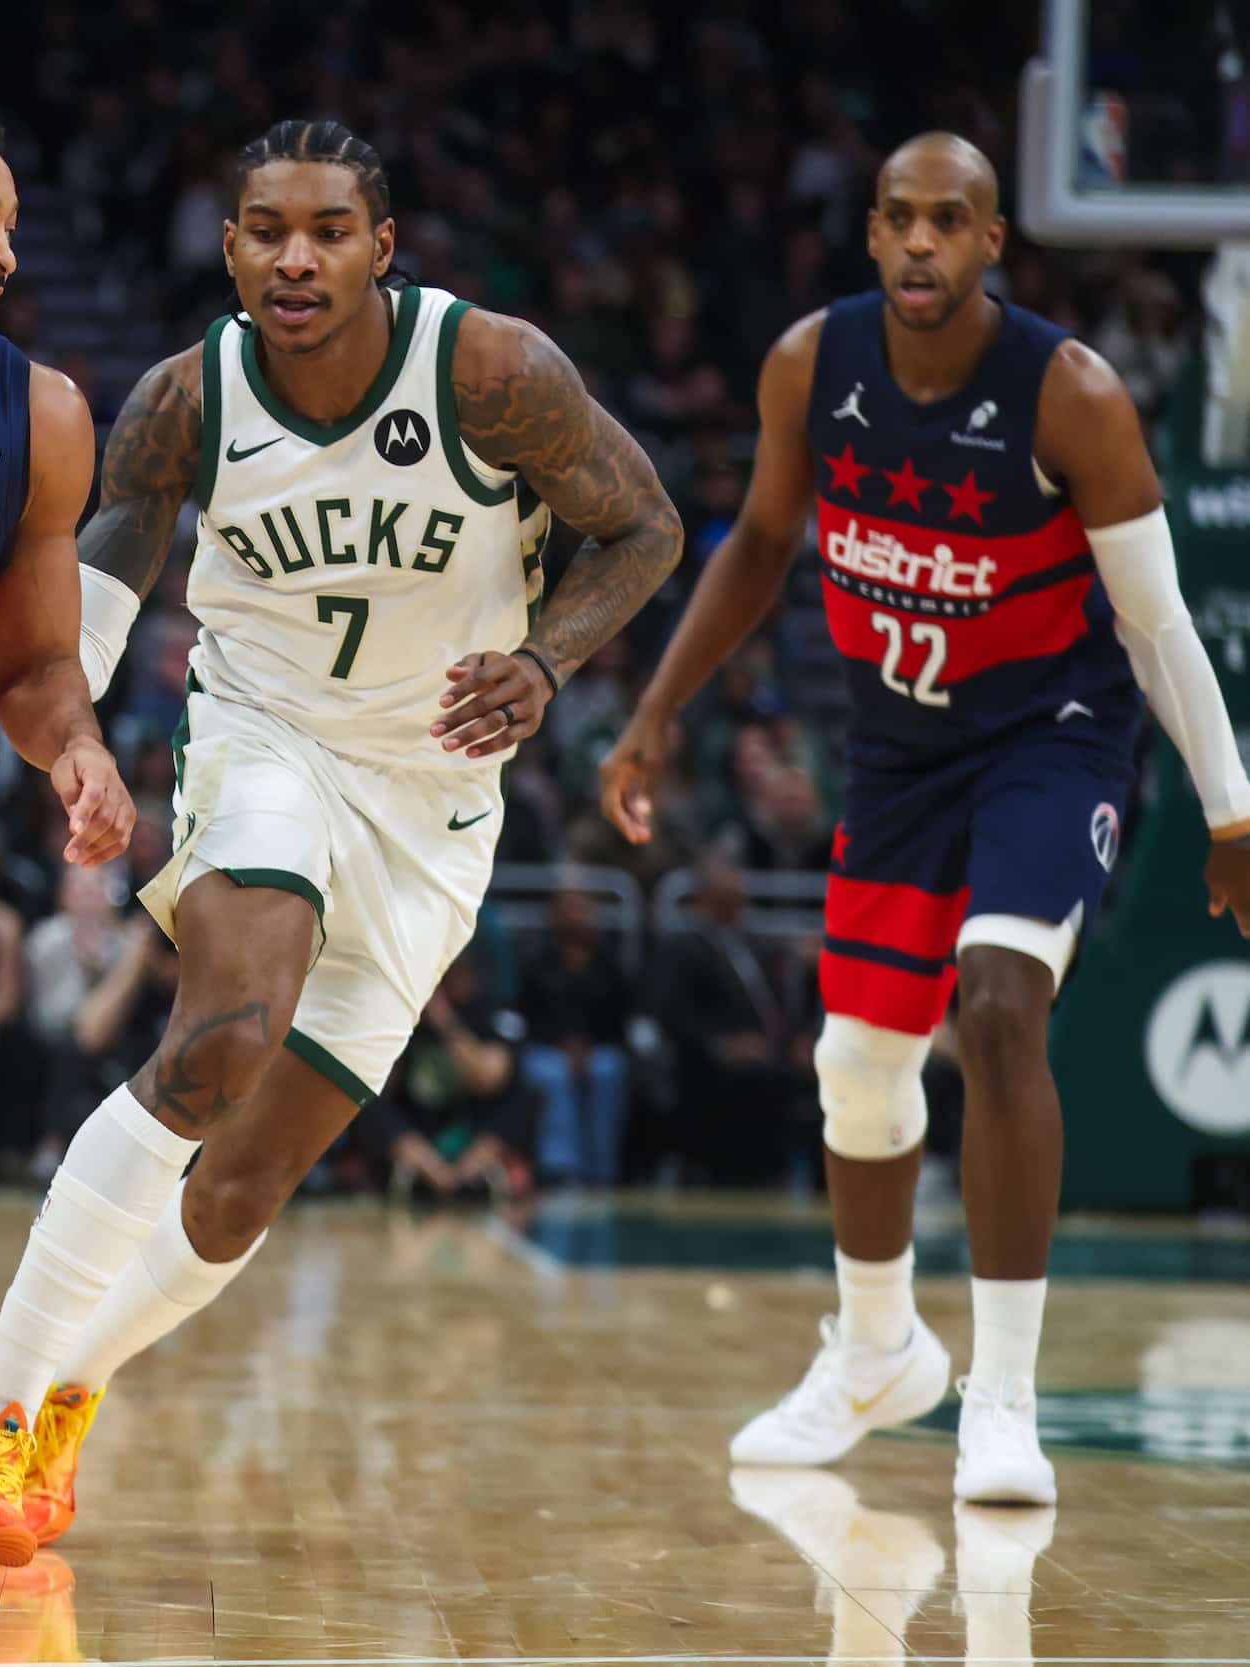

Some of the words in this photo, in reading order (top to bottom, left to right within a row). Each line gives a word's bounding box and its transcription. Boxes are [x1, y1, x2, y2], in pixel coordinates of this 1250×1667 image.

[218, 498, 465, 579] BUCKS
[827, 518, 998, 597] district
[316, 595, 369, 680] 7
[871, 611, 951, 708] 22
